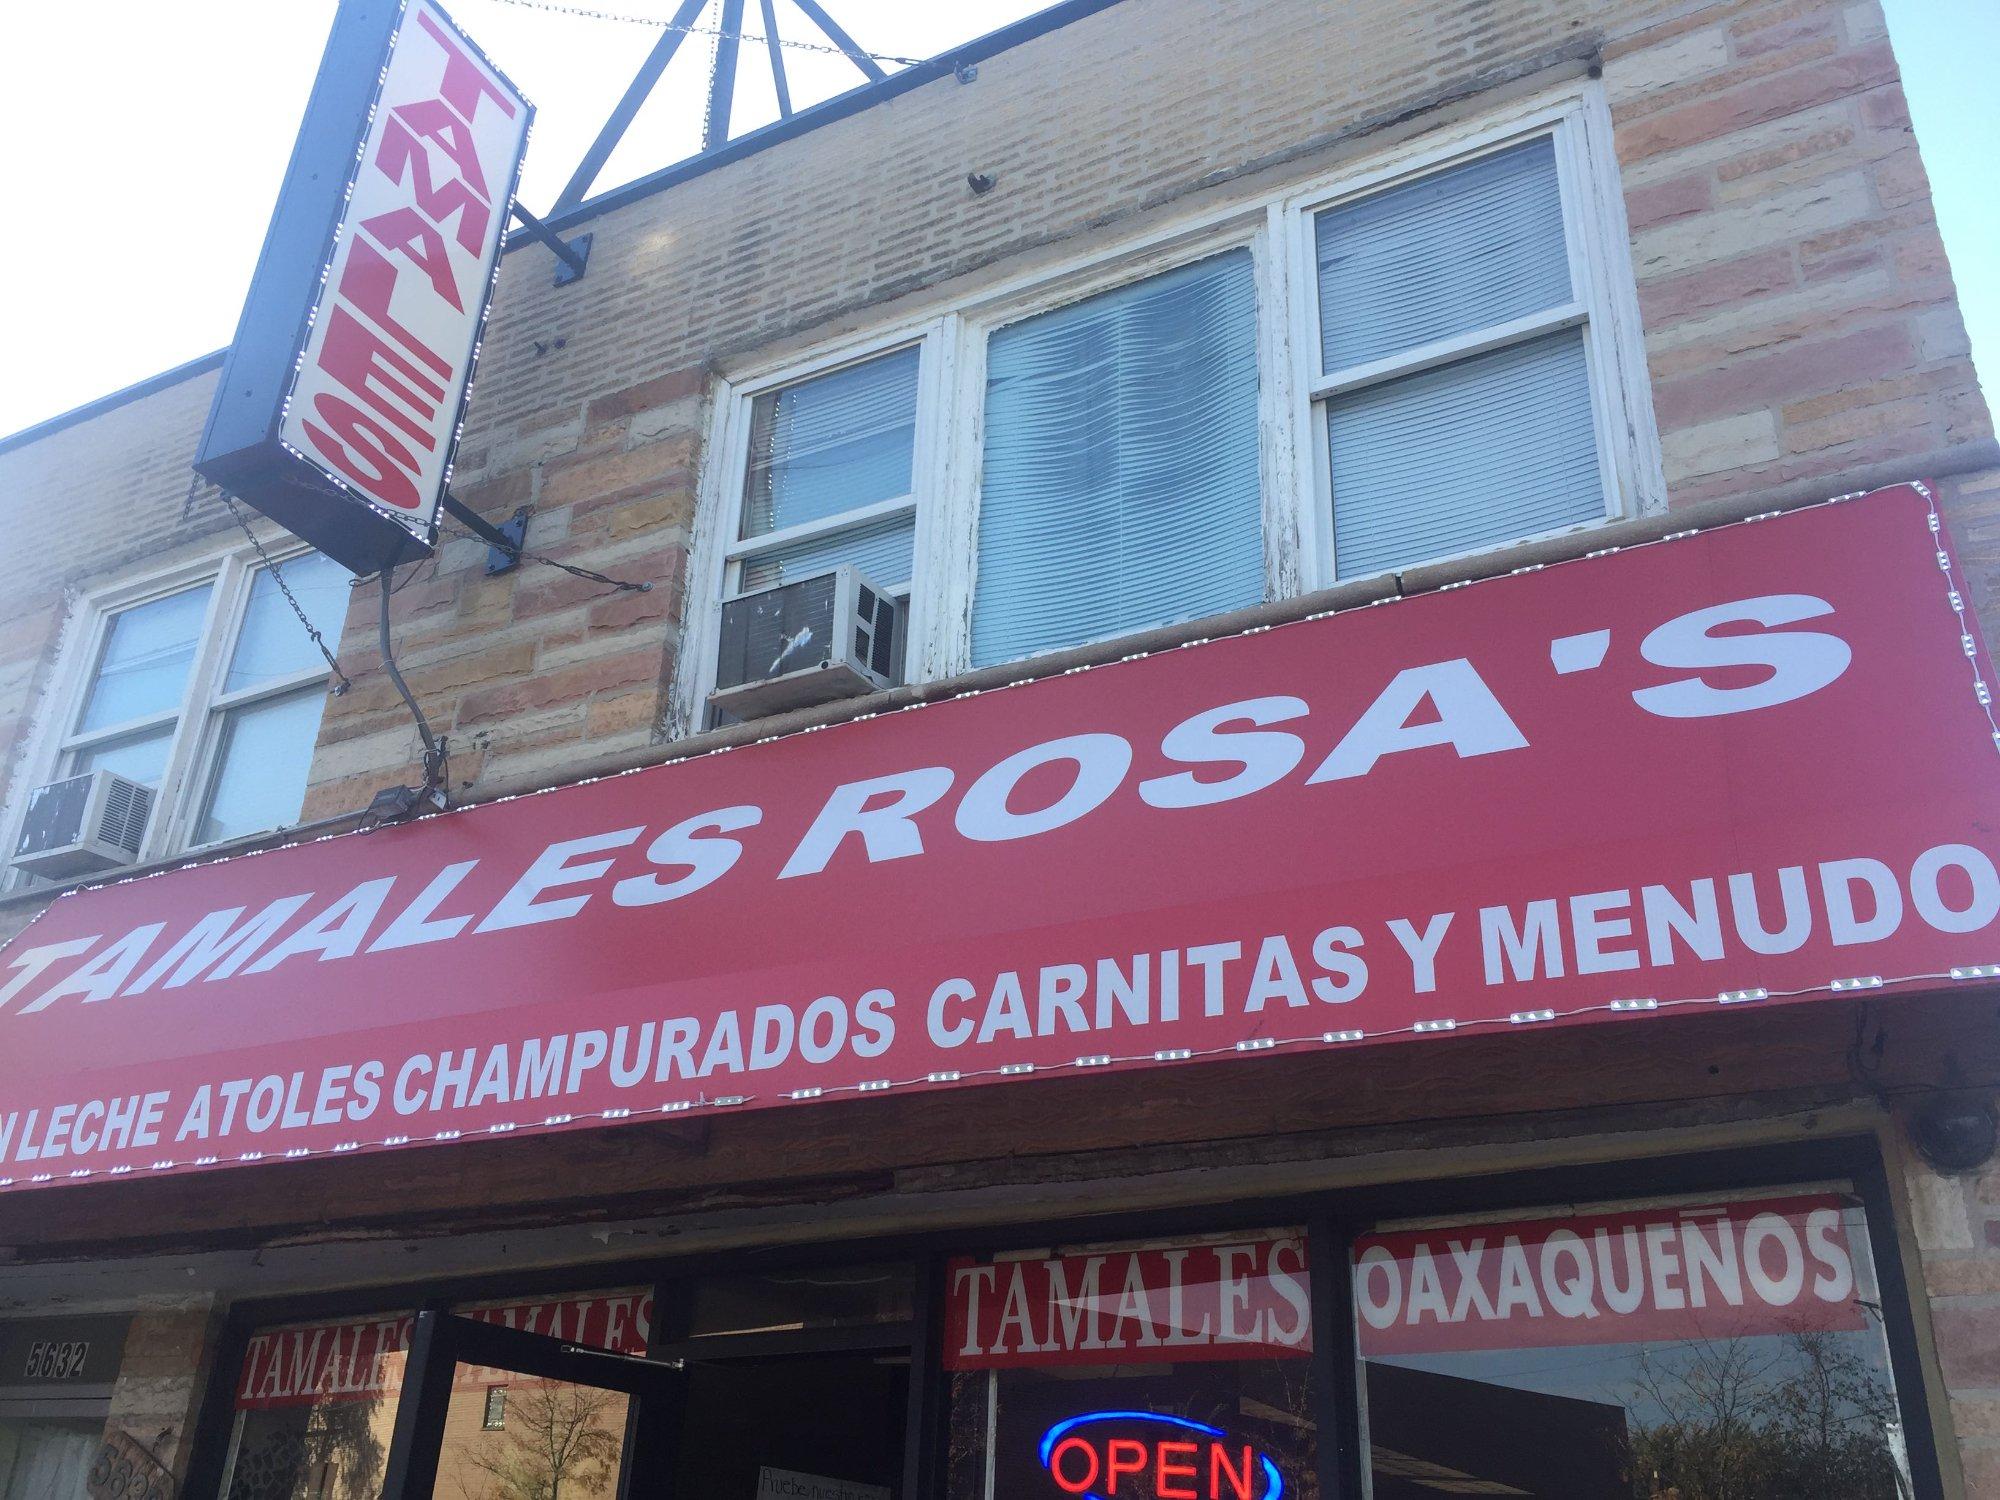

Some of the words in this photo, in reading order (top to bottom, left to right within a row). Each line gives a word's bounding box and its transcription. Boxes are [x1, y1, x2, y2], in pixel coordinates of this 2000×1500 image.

[302, 9, 515, 509] TAMALES
[0, 805, 763, 1015] TAMALES
[776, 594, 1852, 880] ROSA'S
[15, 1091, 170, 1162] LECHE
[176, 1060, 385, 1141] ATOLES
[393, 989, 897, 1112] CHAMPURADOS
[926, 925, 1369, 1048] CARNITAS
[1386, 912, 1455, 994] Y
[1479, 843, 2000, 986] MENUDO
[954, 1238, 1310, 1357] TAMALES
[1356, 1206, 1854, 1329] OAXAQUEÑOS
[27, 1343, 88, 1378] 5632
[1051, 1437, 1252, 1500] OPEN
